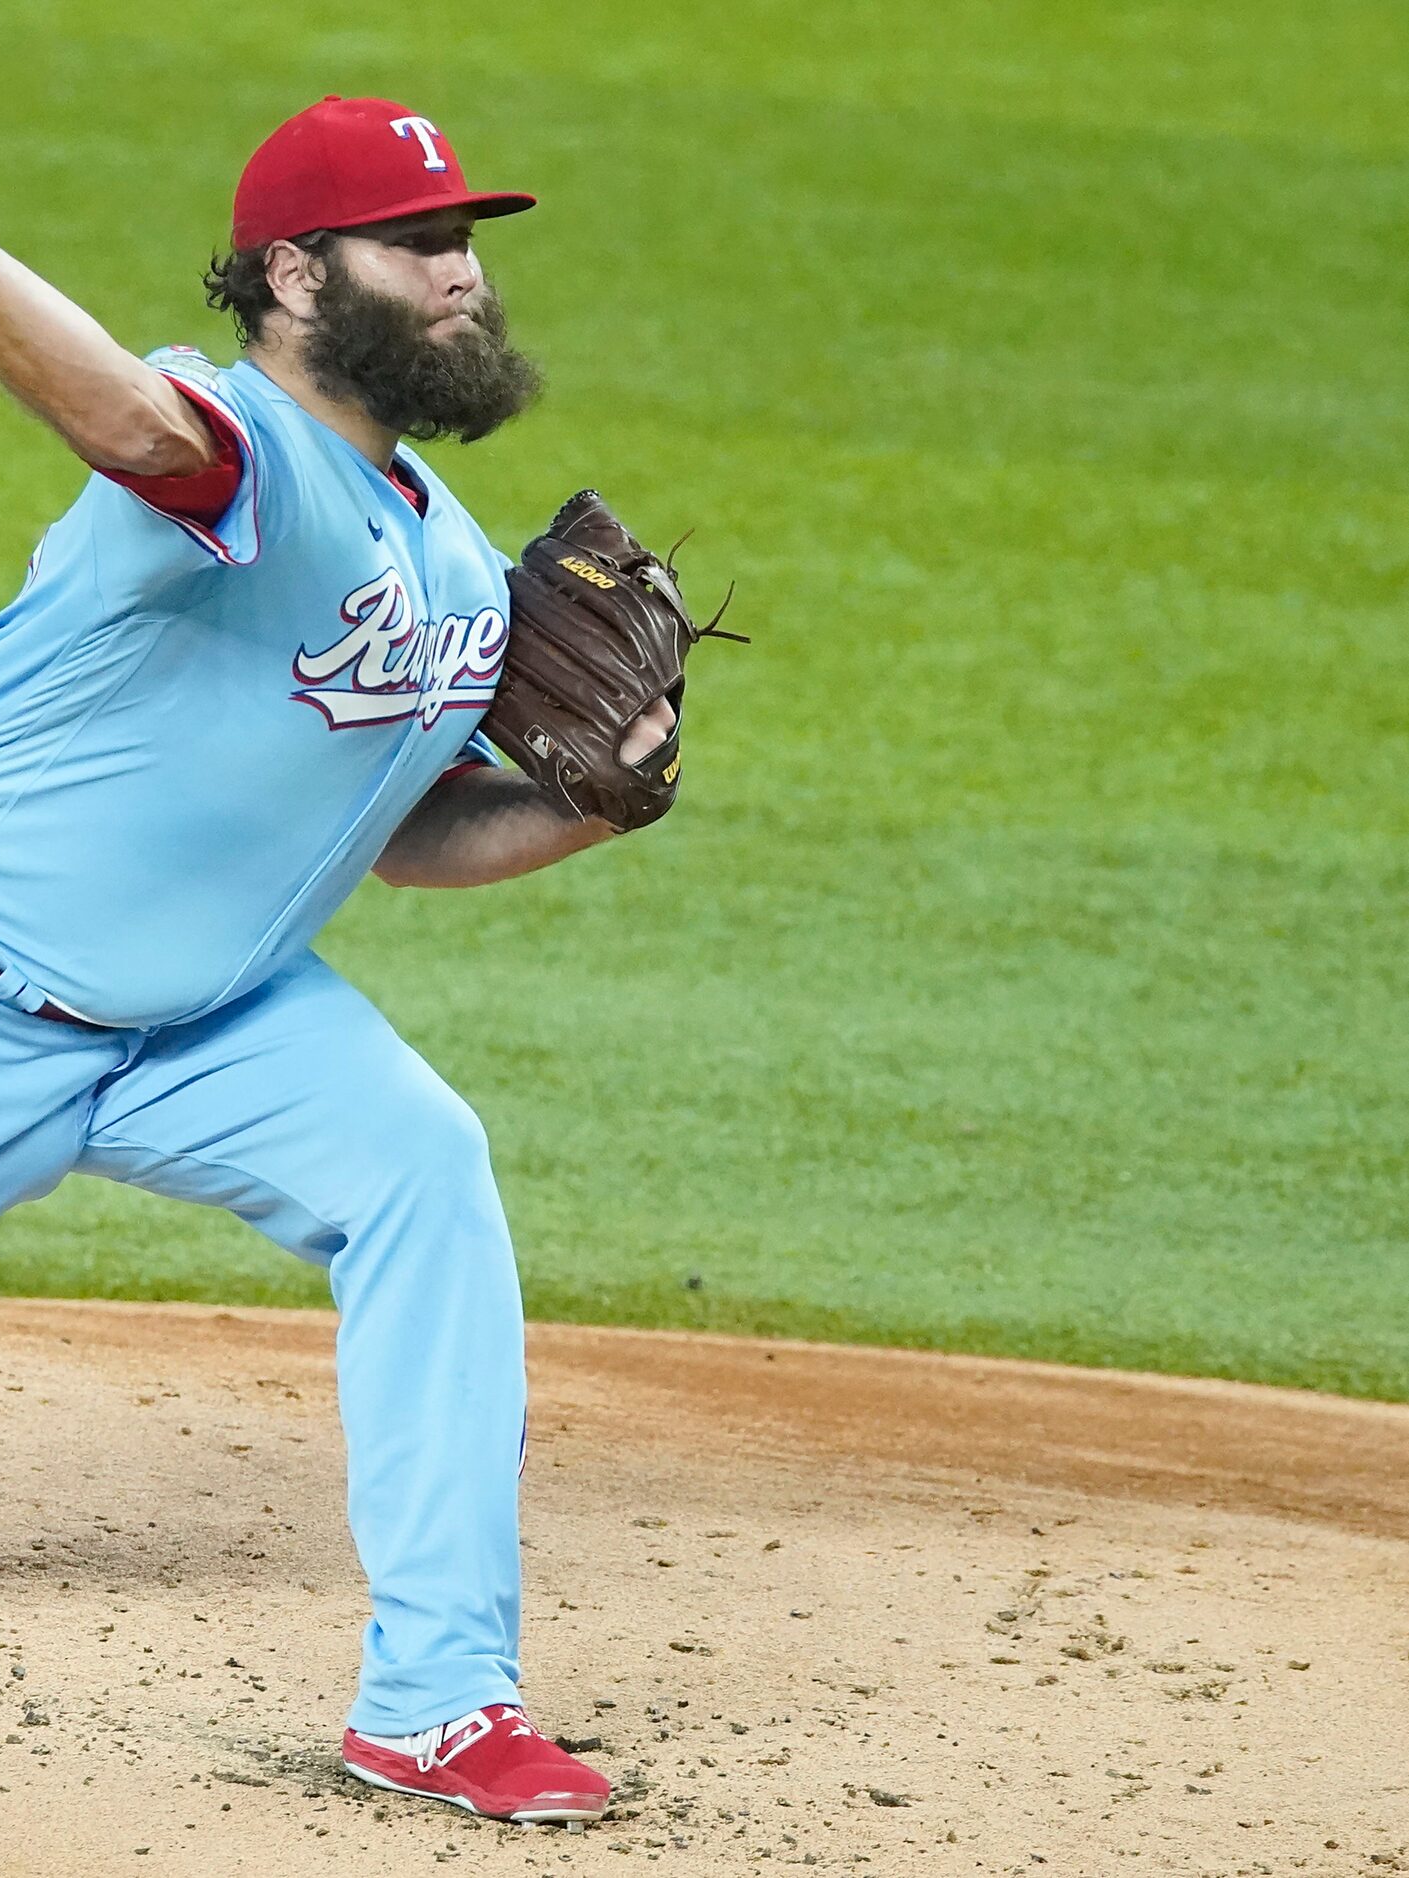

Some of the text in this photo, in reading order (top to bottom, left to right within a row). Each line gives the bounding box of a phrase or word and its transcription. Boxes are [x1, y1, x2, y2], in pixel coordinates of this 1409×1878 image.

[388, 115, 448, 172] T
[556, 555, 617, 590] A2000
[291, 566, 509, 732] Range
